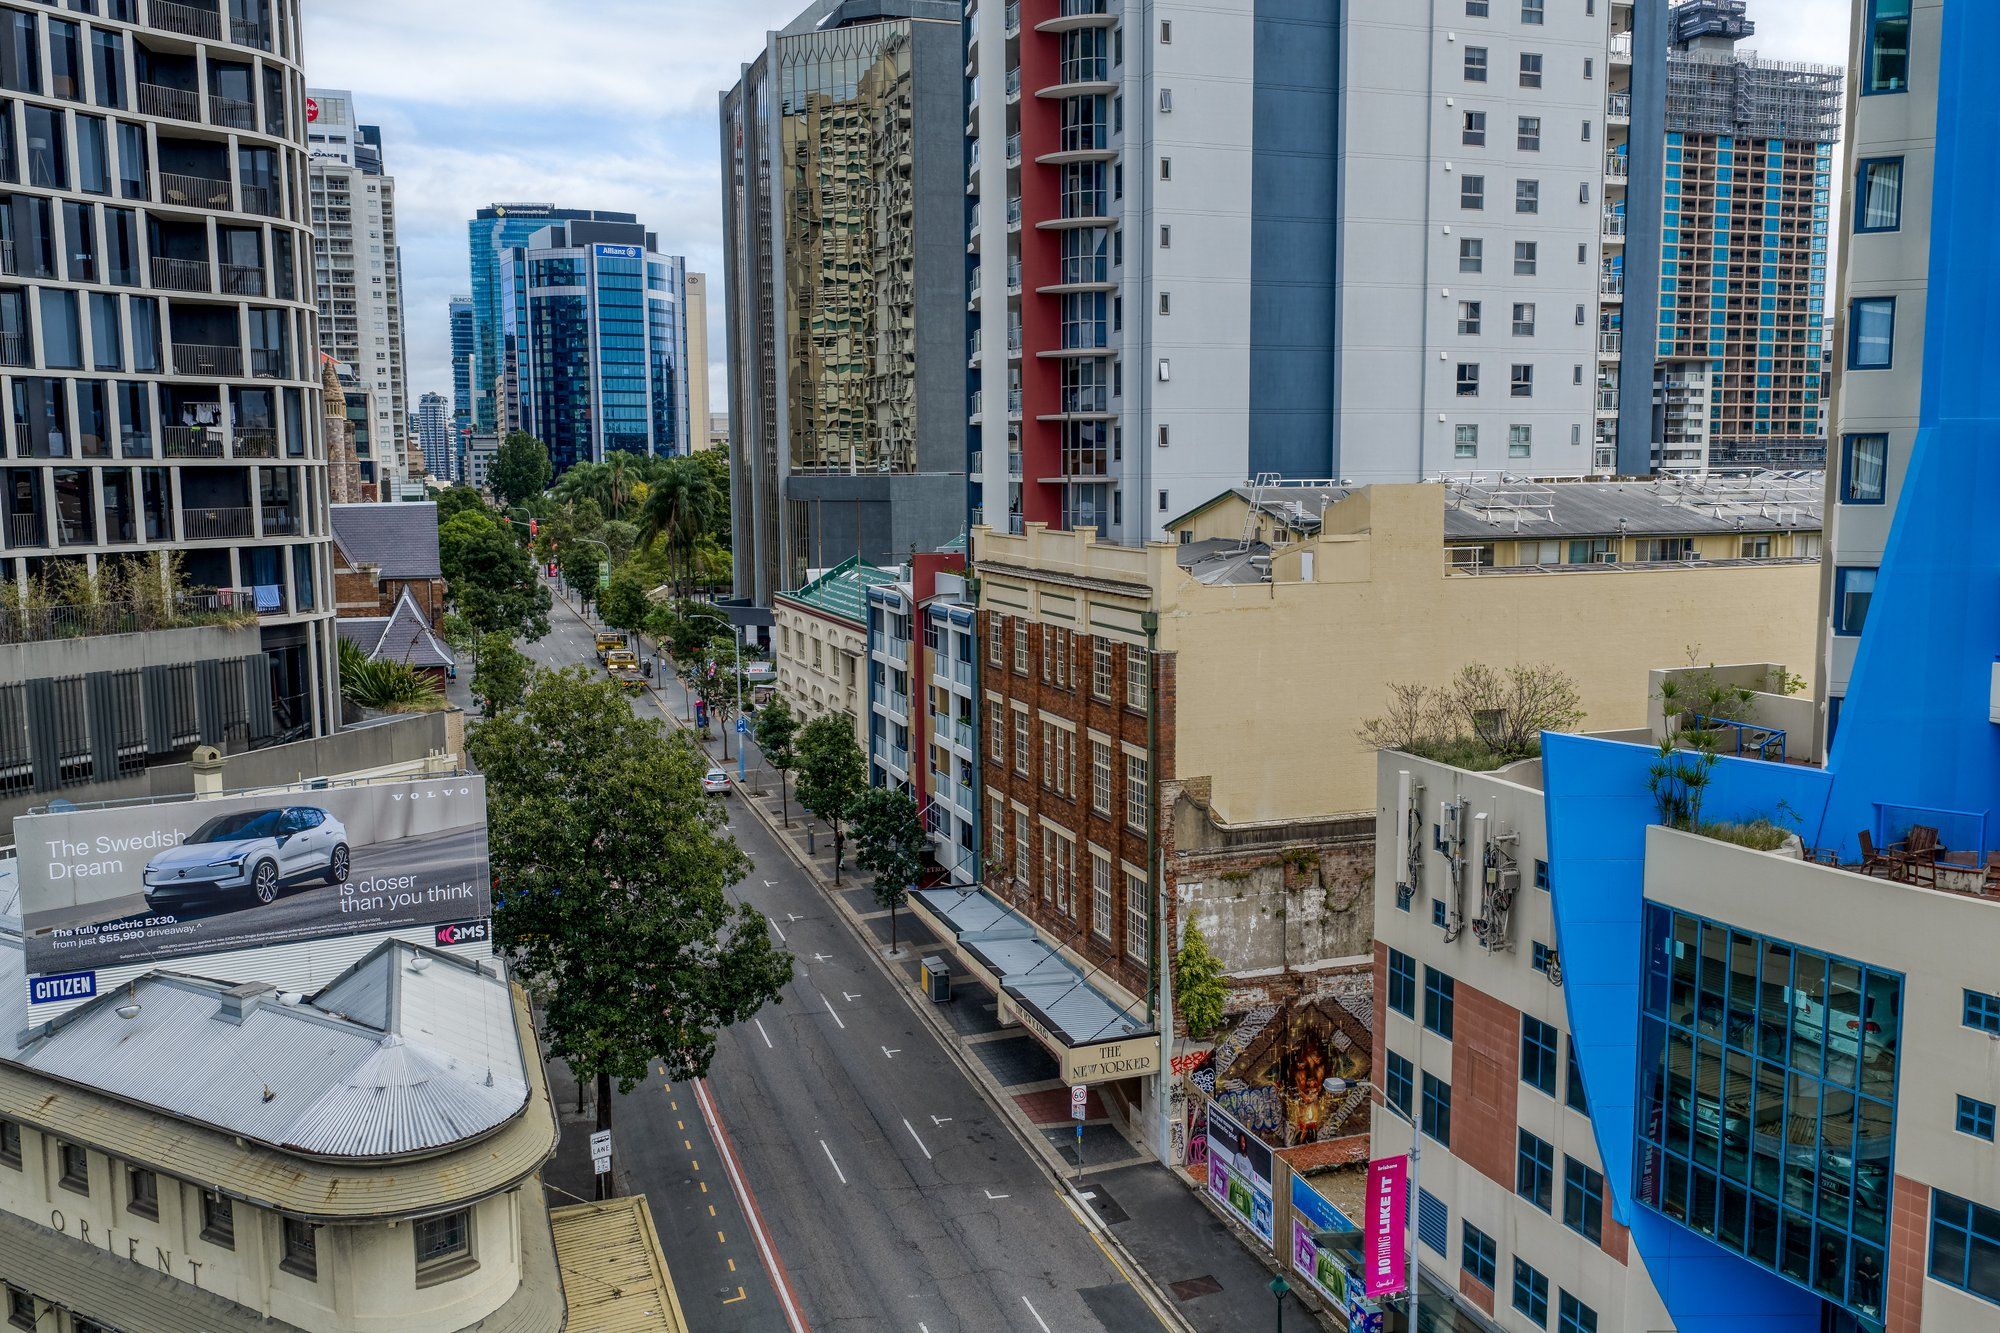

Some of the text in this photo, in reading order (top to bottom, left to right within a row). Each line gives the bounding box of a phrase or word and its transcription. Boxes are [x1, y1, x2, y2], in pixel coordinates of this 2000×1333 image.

[602, 247, 626, 255] Allianz
[392, 788, 469, 800] VOLVO
[46, 828, 186, 858] The Swedish
[50, 860, 122, 880] Dream
[360, 876, 417, 894] closer
[340, 882, 474, 913] than you think
[52, 915, 178, 938] The fully electric EX30,
[52, 940, 76, 950] from
[78, 937, 96, 948] just
[98, 930, 144, 944] $55,990
[36, 976, 90, 999] CITIZEN
[1100, 1044, 1121, 1058] THE
[1072, 1056, 1150, 1079] NEW YORKER
[1074, 1091, 1084, 1099] 60
[593, 1145, 610, 1154] LANE
[1380, 1176, 1393, 1194] IT
[1379, 1196, 1392, 1235] LIKE
[52, 1210, 203, 1285] ORIENT
[1377, 1234, 1392, 1276] NOTHING
